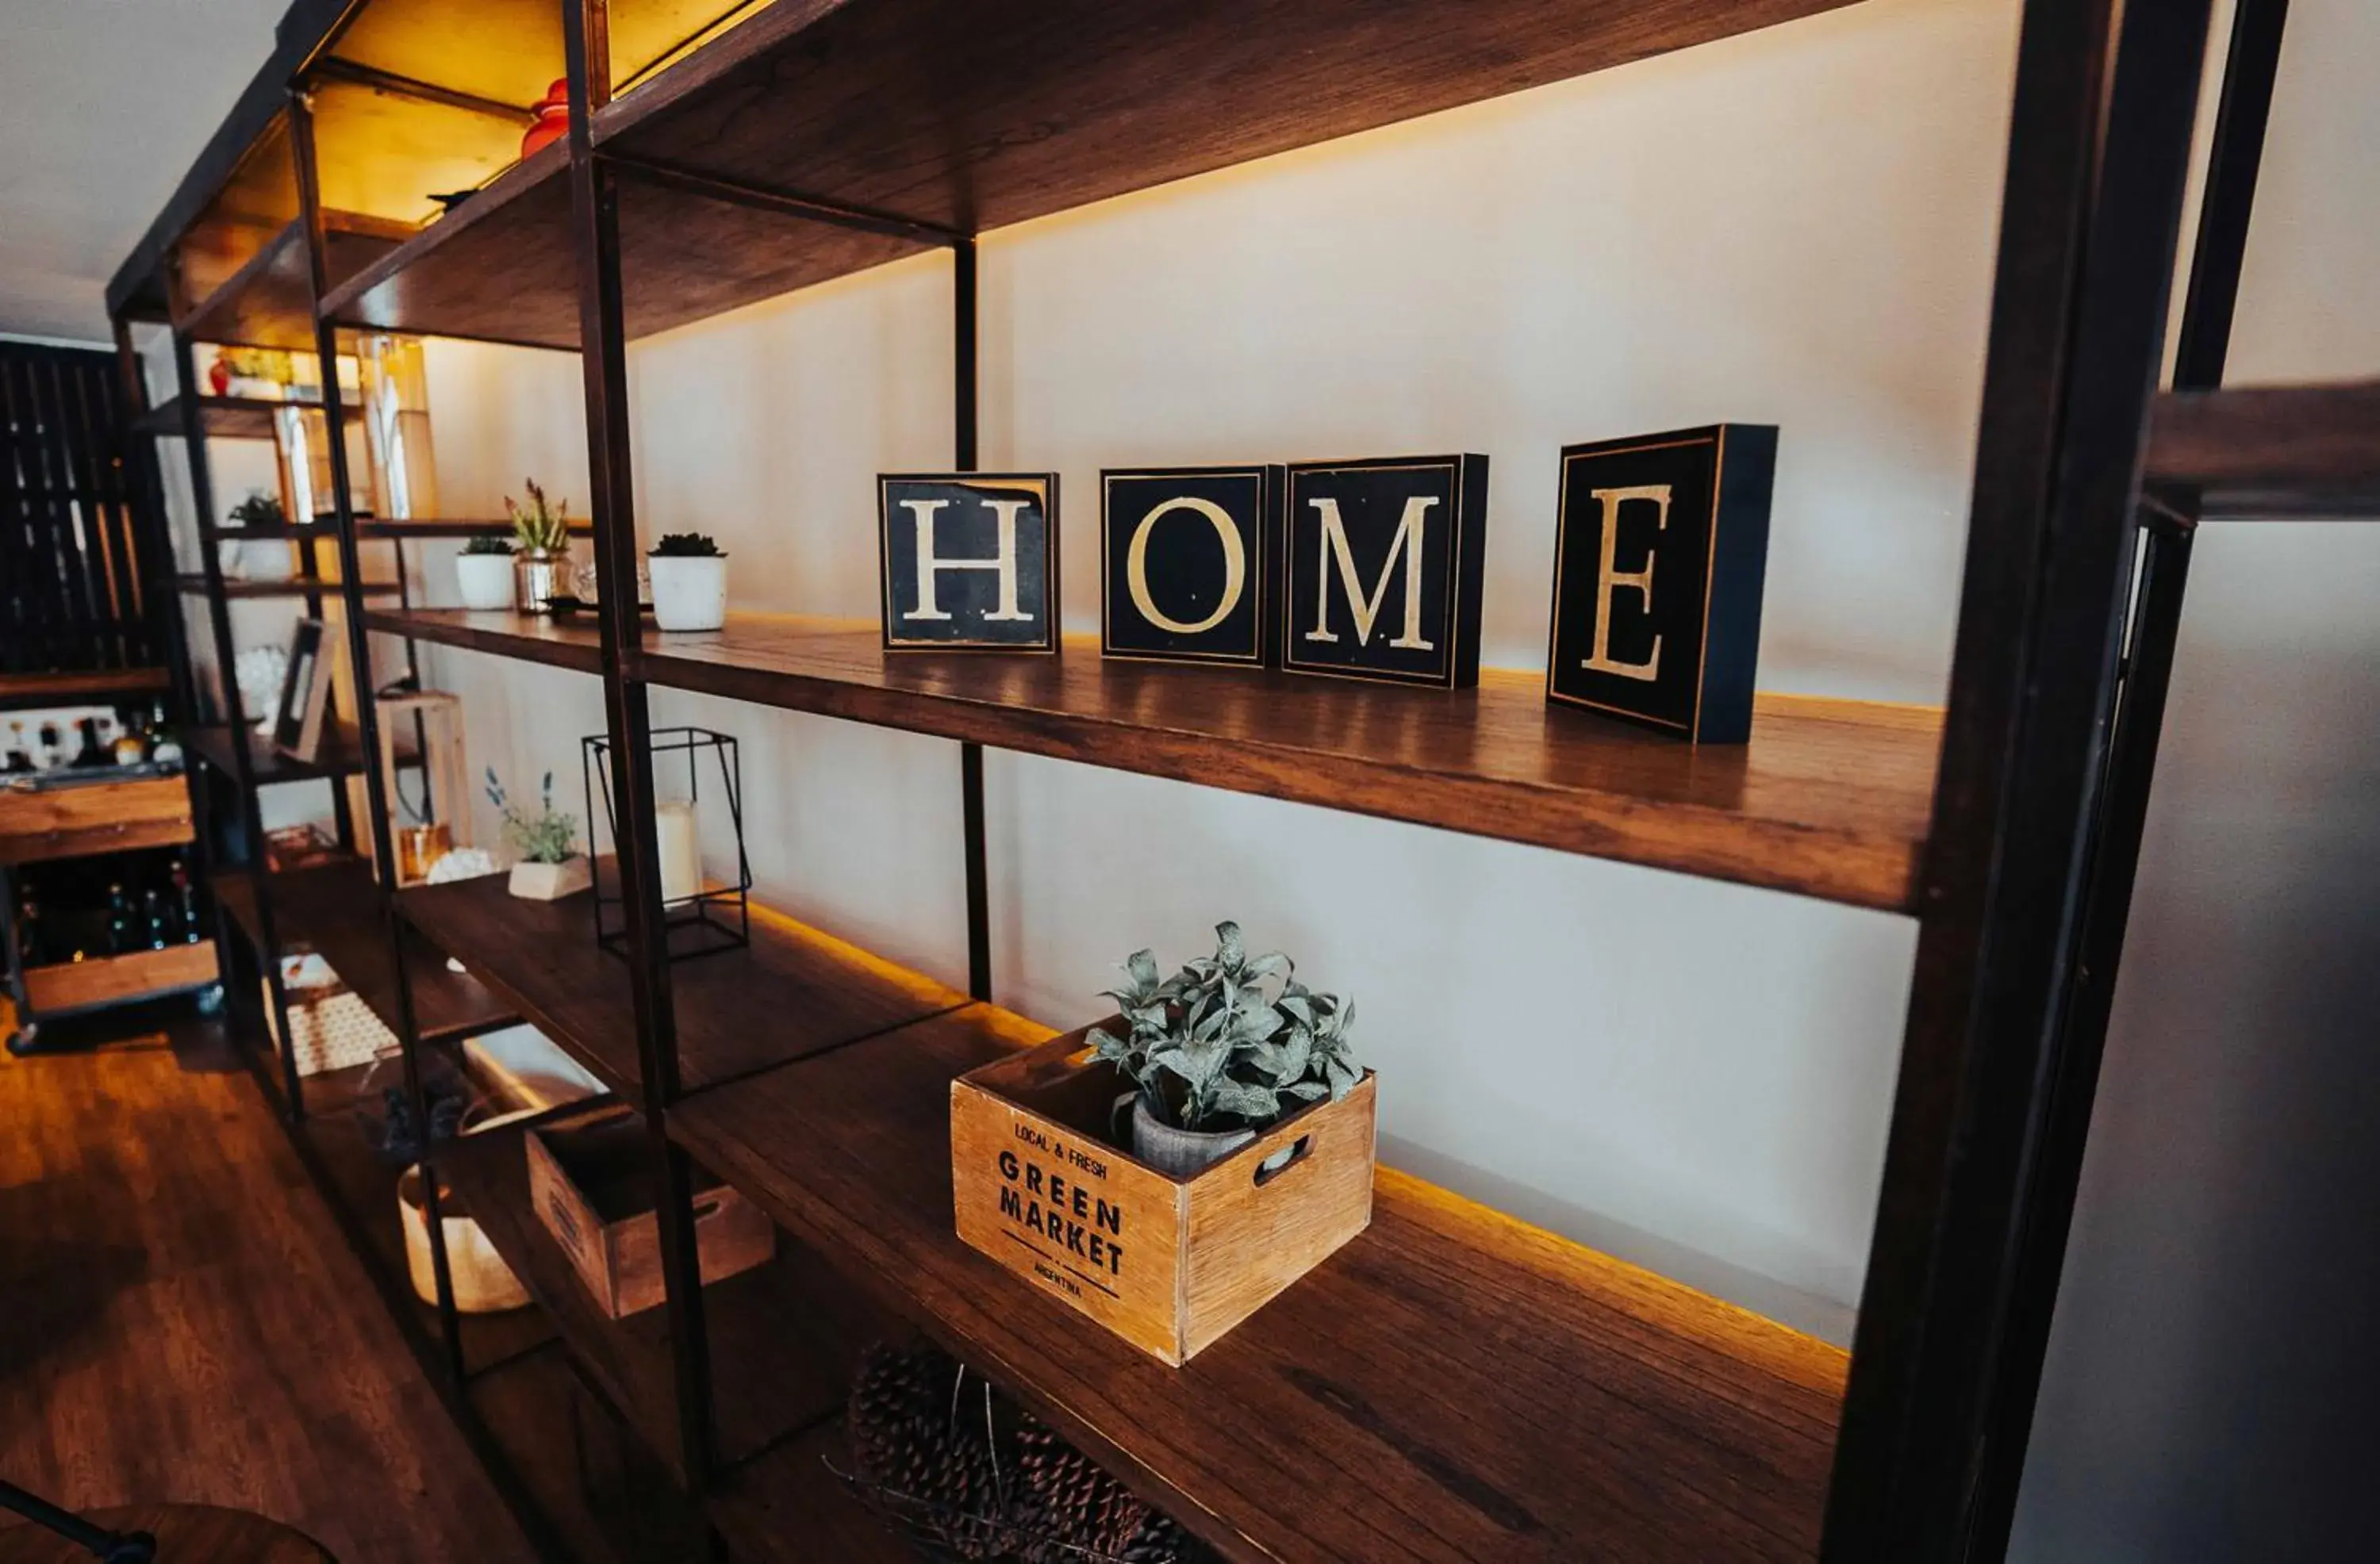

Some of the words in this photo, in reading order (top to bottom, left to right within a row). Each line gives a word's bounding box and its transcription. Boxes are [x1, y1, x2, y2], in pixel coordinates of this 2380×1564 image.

[1015, 1123, 1049, 1150] LOCAL
[1054, 1143, 1064, 1159] &
[1069, 1150, 1107, 1180] FRESH
[999, 1151, 1120, 1236] GREEN
[1000, 1186, 1123, 1275] MARKET
[1034, 1262, 1081, 1298] ARGENTINA
